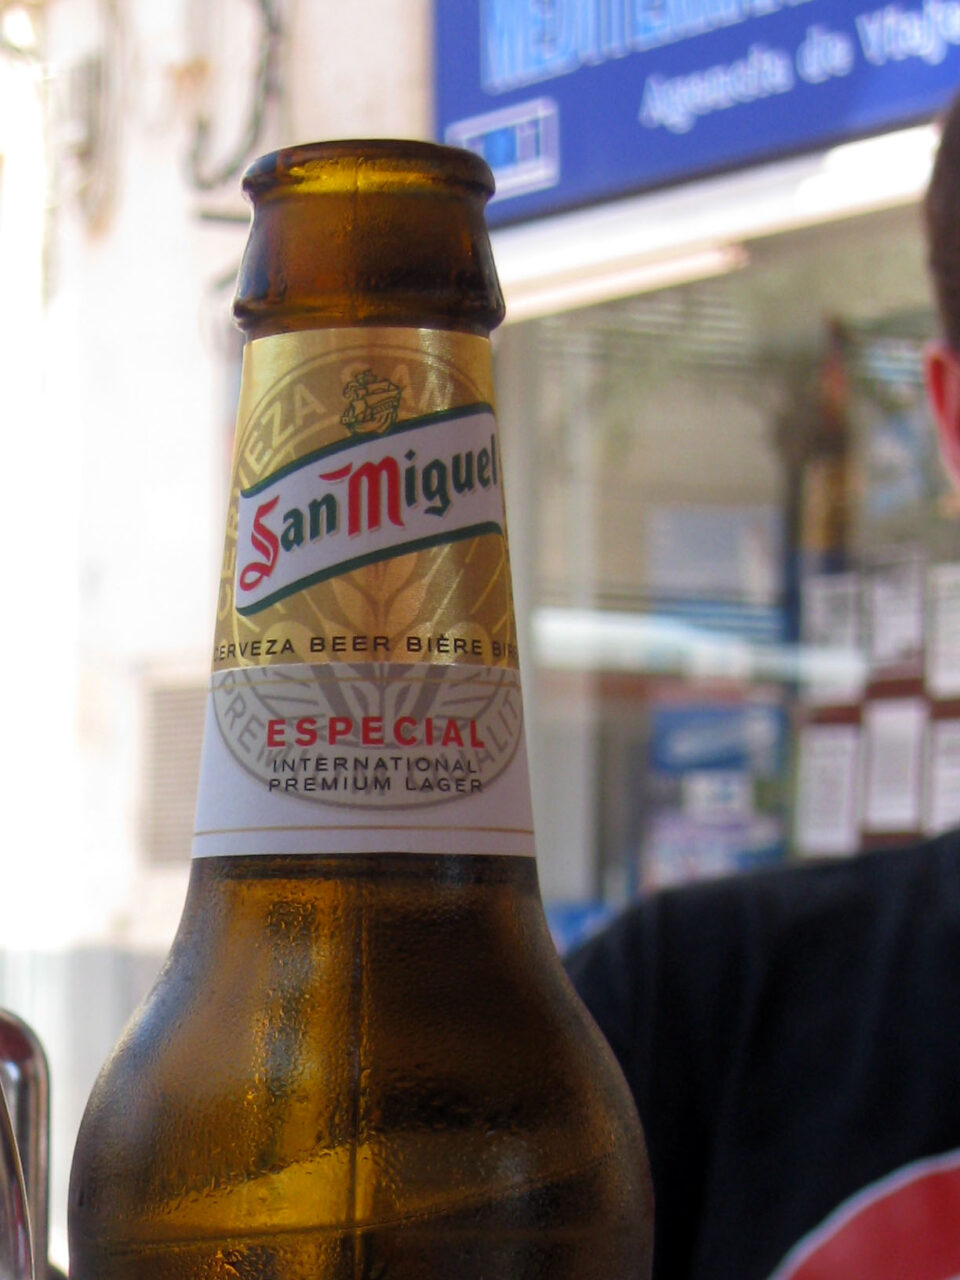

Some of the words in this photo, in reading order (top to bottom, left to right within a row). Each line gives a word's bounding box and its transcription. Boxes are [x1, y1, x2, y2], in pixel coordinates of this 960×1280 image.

[239, 495, 339, 592] San
[319, 434, 498, 538] Miguel
[309, 635, 391, 653] BEER
[406, 634, 483, 656] BIÈRE
[266, 716, 485, 748] ESPECIAL
[273, 756, 478, 774] INTERNATIONAL
[268, 777, 391, 793] PREMIUM
[405, 777, 483, 794] LAGER
